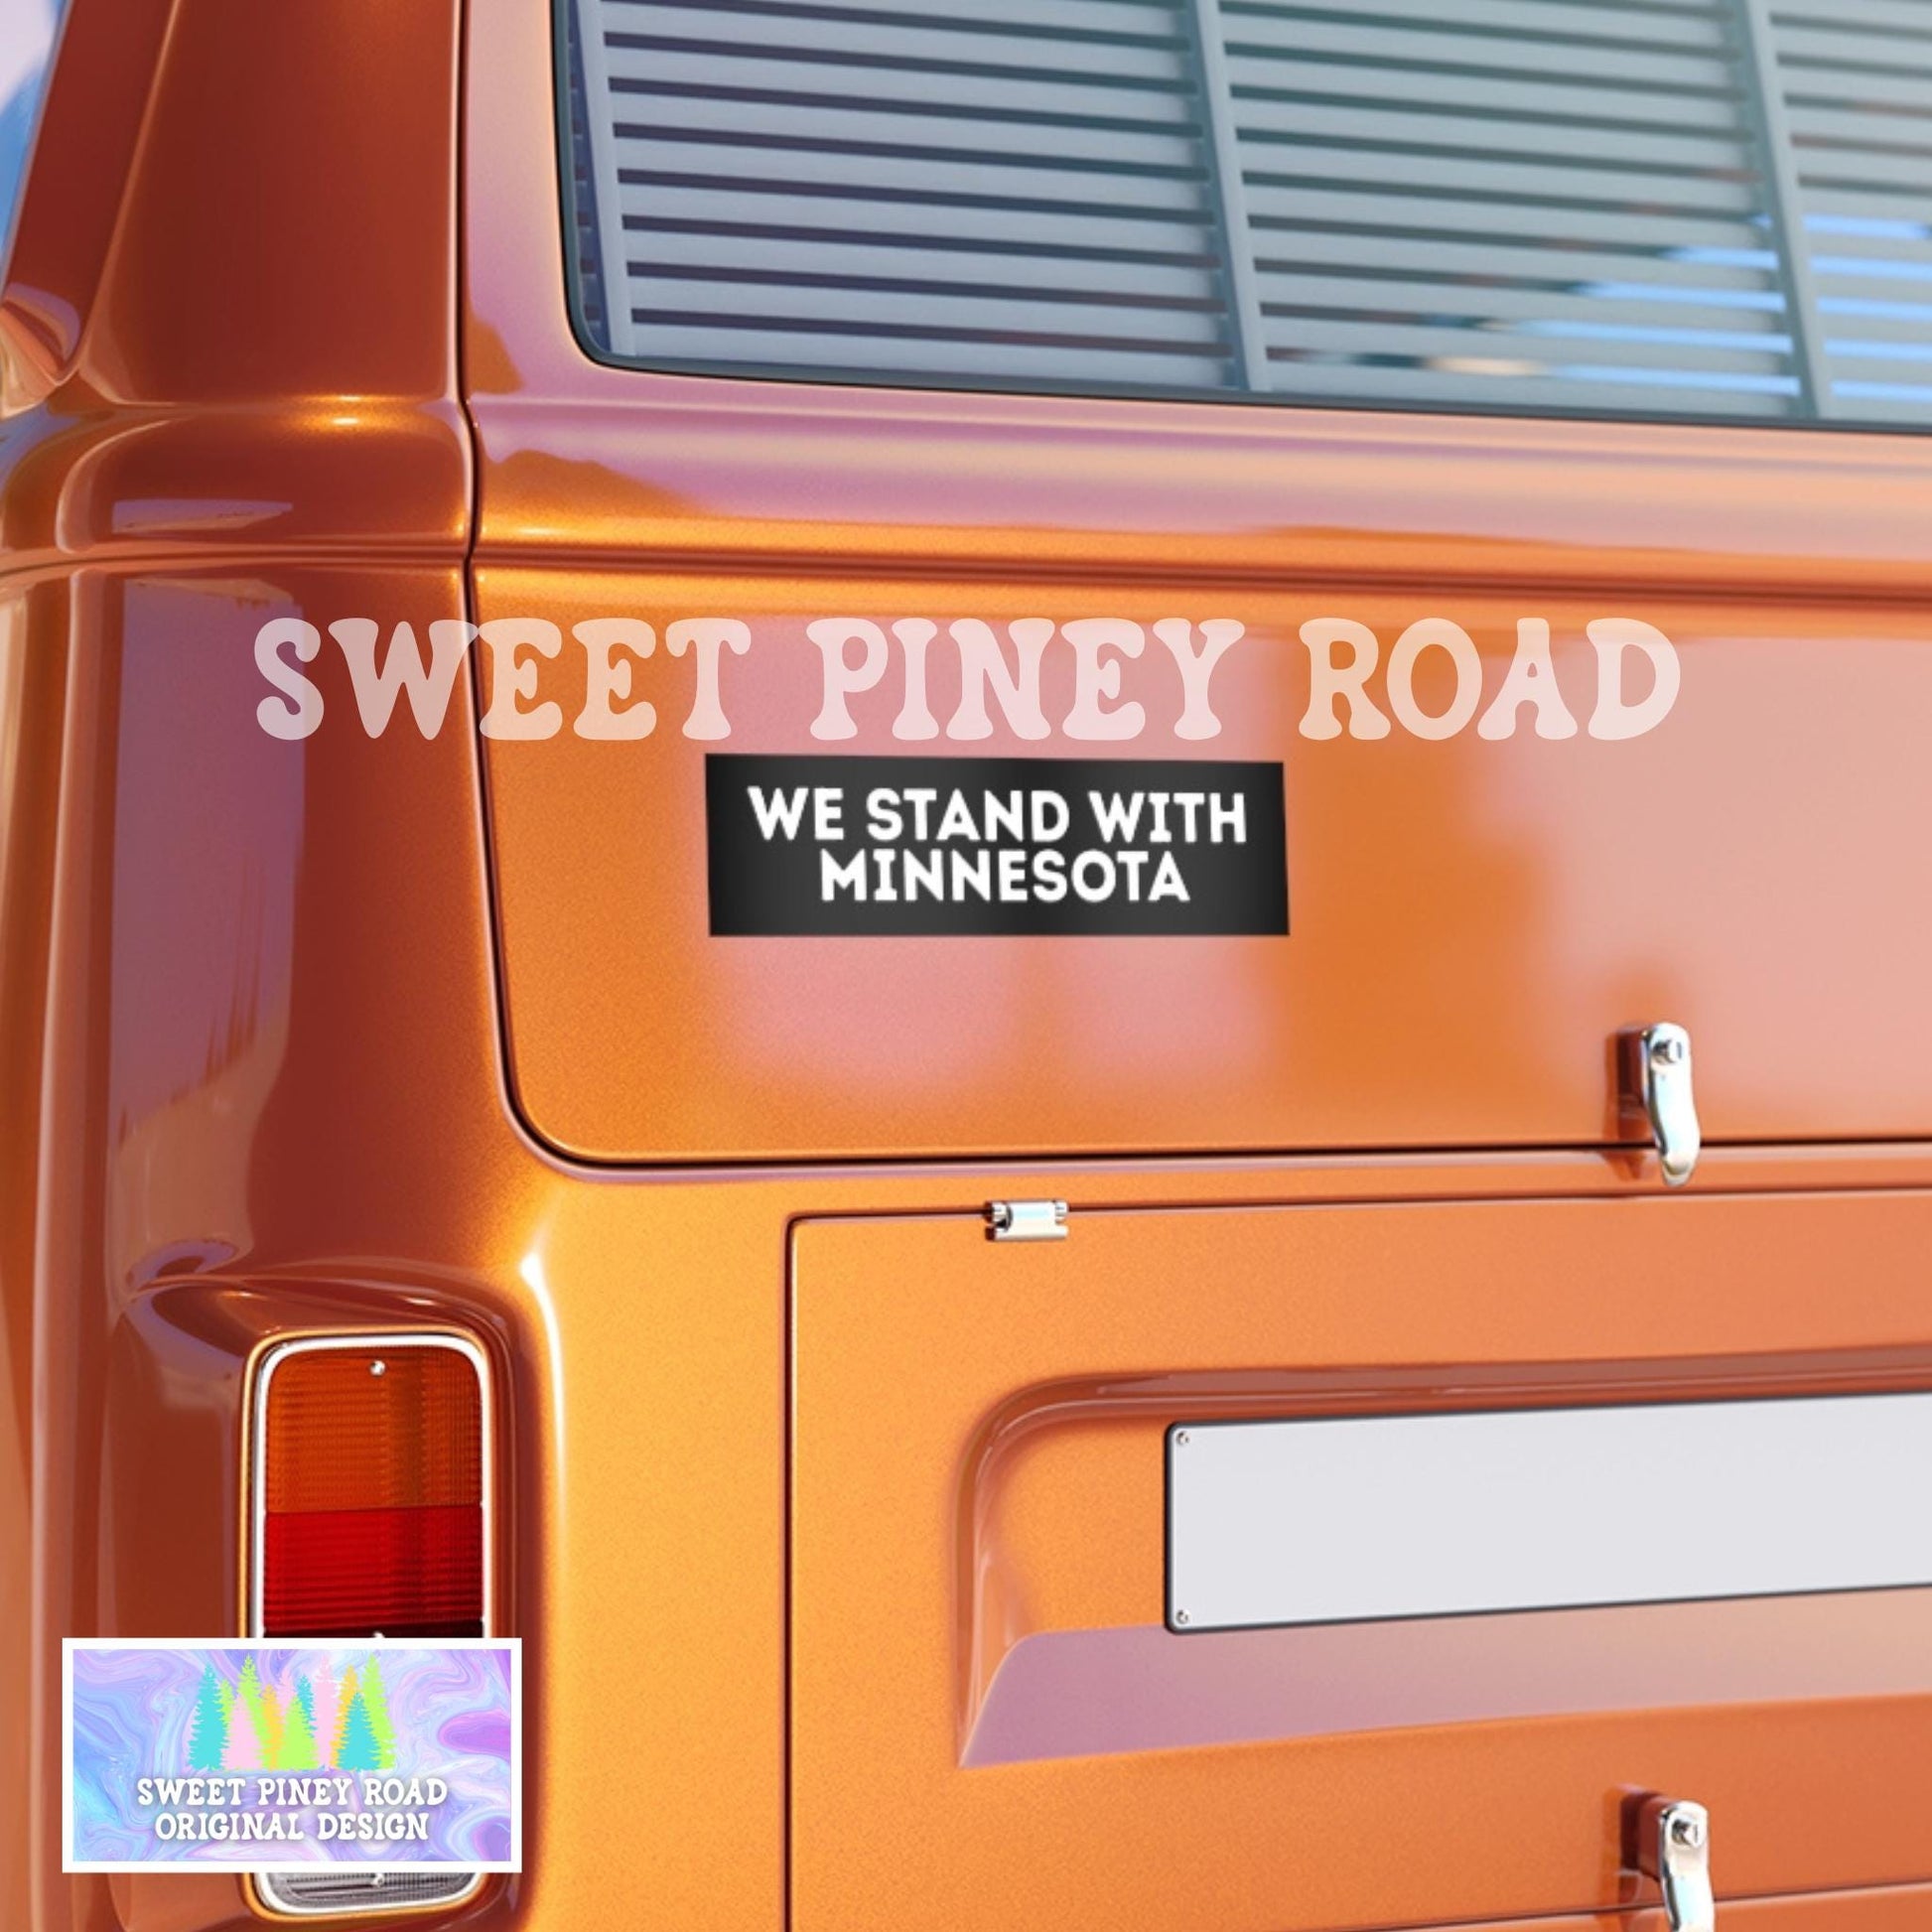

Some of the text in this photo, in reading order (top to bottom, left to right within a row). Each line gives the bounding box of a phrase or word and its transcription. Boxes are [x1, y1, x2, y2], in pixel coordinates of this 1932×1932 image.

[747, 785, 1248, 844] WE STAND WITH
[820, 848, 1191, 902] MINNESOTA
